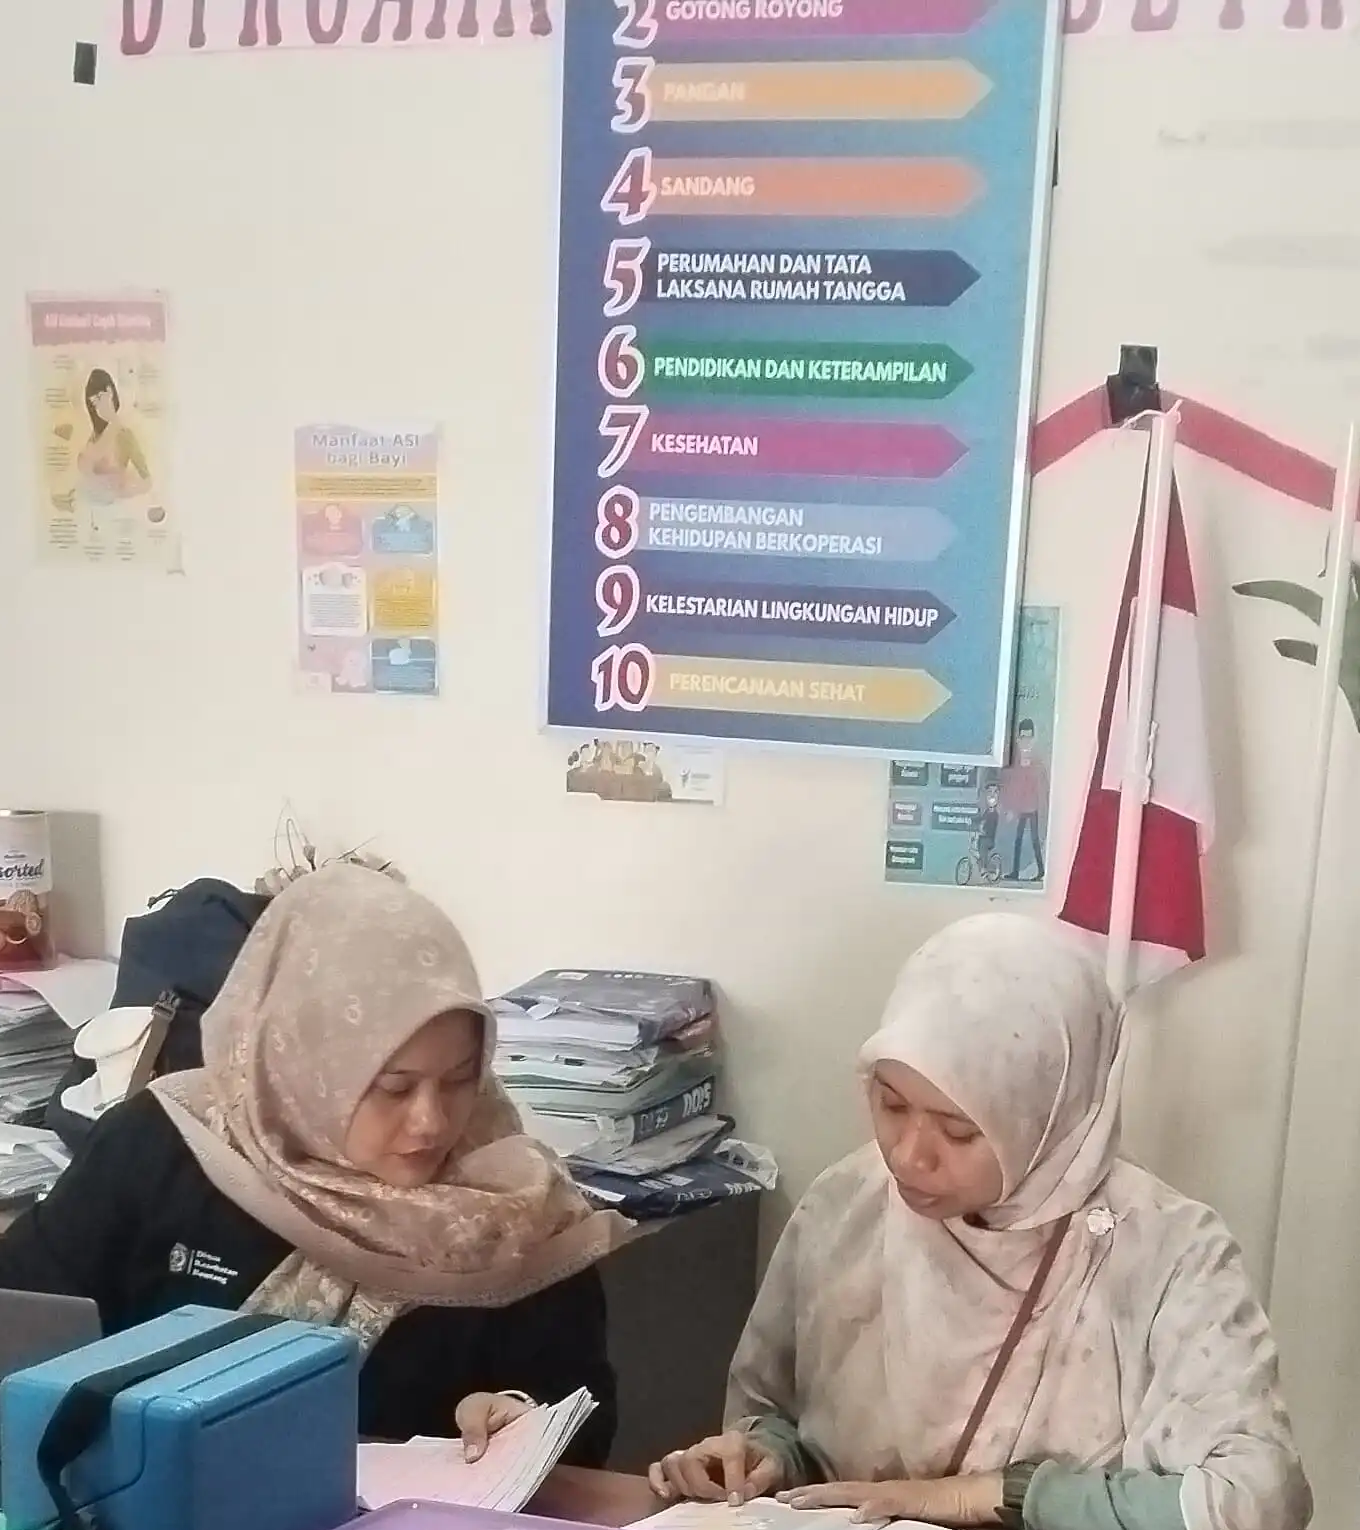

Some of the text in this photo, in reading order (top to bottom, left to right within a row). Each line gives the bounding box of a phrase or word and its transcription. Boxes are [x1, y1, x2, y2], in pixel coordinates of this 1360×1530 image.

[613, 0, 844, 49] 2 GOTONG ROYONG
[610, 56, 746, 134] 3 PANGAN
[600, 146, 755, 225] 4 SANDANG
[603, 236, 872, 317] 5 PERUMAHAN DAN TATA
[656, 279, 906, 302] LAKSANA RUMAH TANGGA
[597, 325, 947, 398] 6 PENDIDIKAN DAN KETERAMPILAN
[312, 432, 420, 448] Manfaat ASI
[326, 451, 408, 469] bagi Bayi
[597, 404, 759, 479] 7 KESEHATAN
[594, 485, 804, 560] 8 PENGEMBANGAN
[648, 527, 883, 555] KEHIDUPAN BERKOPERASI
[595, 564, 939, 638] 9 KELESTARIAN LINGKUNGAN HIDUP
[591, 642, 866, 713] 10 PERENCANAAN SEHAT
